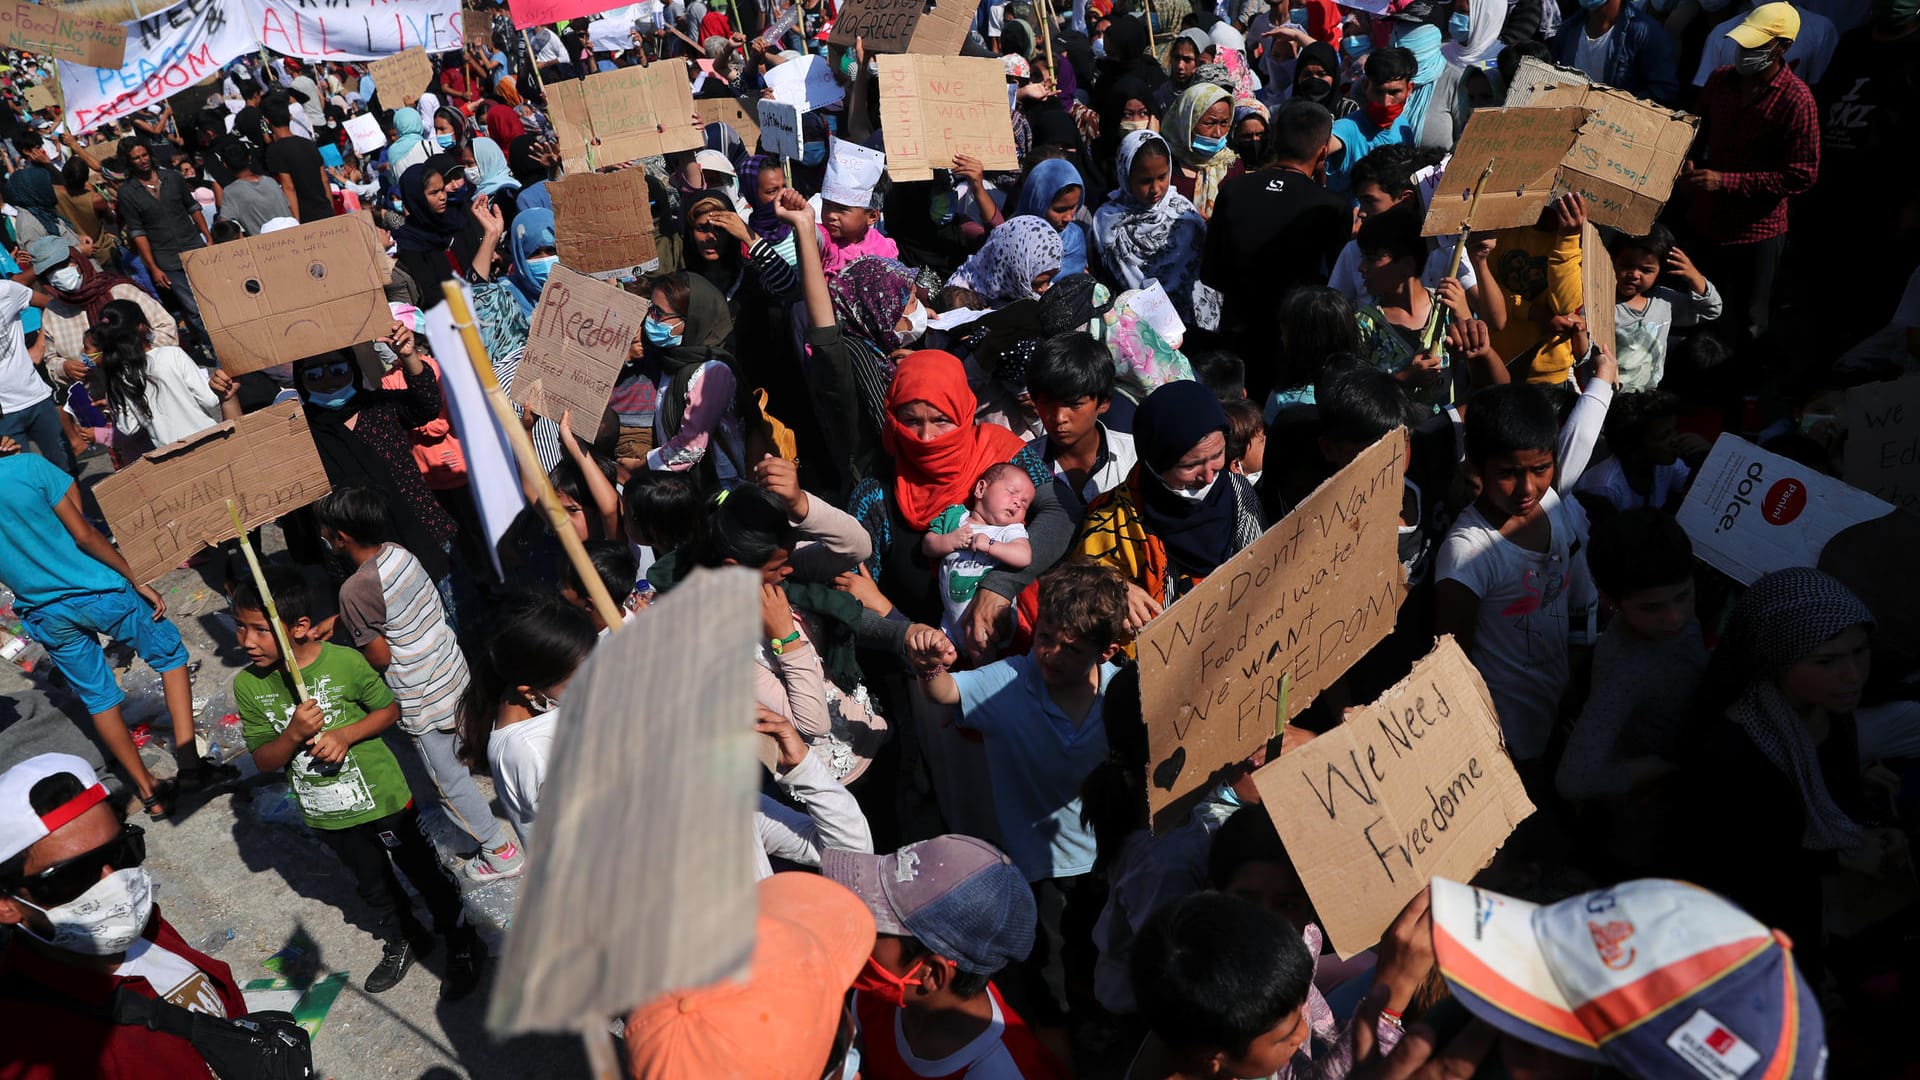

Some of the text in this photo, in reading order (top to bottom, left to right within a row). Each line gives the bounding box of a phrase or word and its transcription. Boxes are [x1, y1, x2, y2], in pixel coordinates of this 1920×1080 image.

[263, 7, 346, 56] ALL
[362, 12, 464, 53] LIVES
[1150, 442, 1403, 667] We Dont Want
[1714, 462, 1764, 534] dolce.
[1200, 521, 1370, 685] Food and water
[1237, 581, 1398, 742] FREEDOM
[1172, 680, 1230, 742] We
[1301, 682, 1451, 821] We Need
[1363, 756, 1484, 885] Freedome
